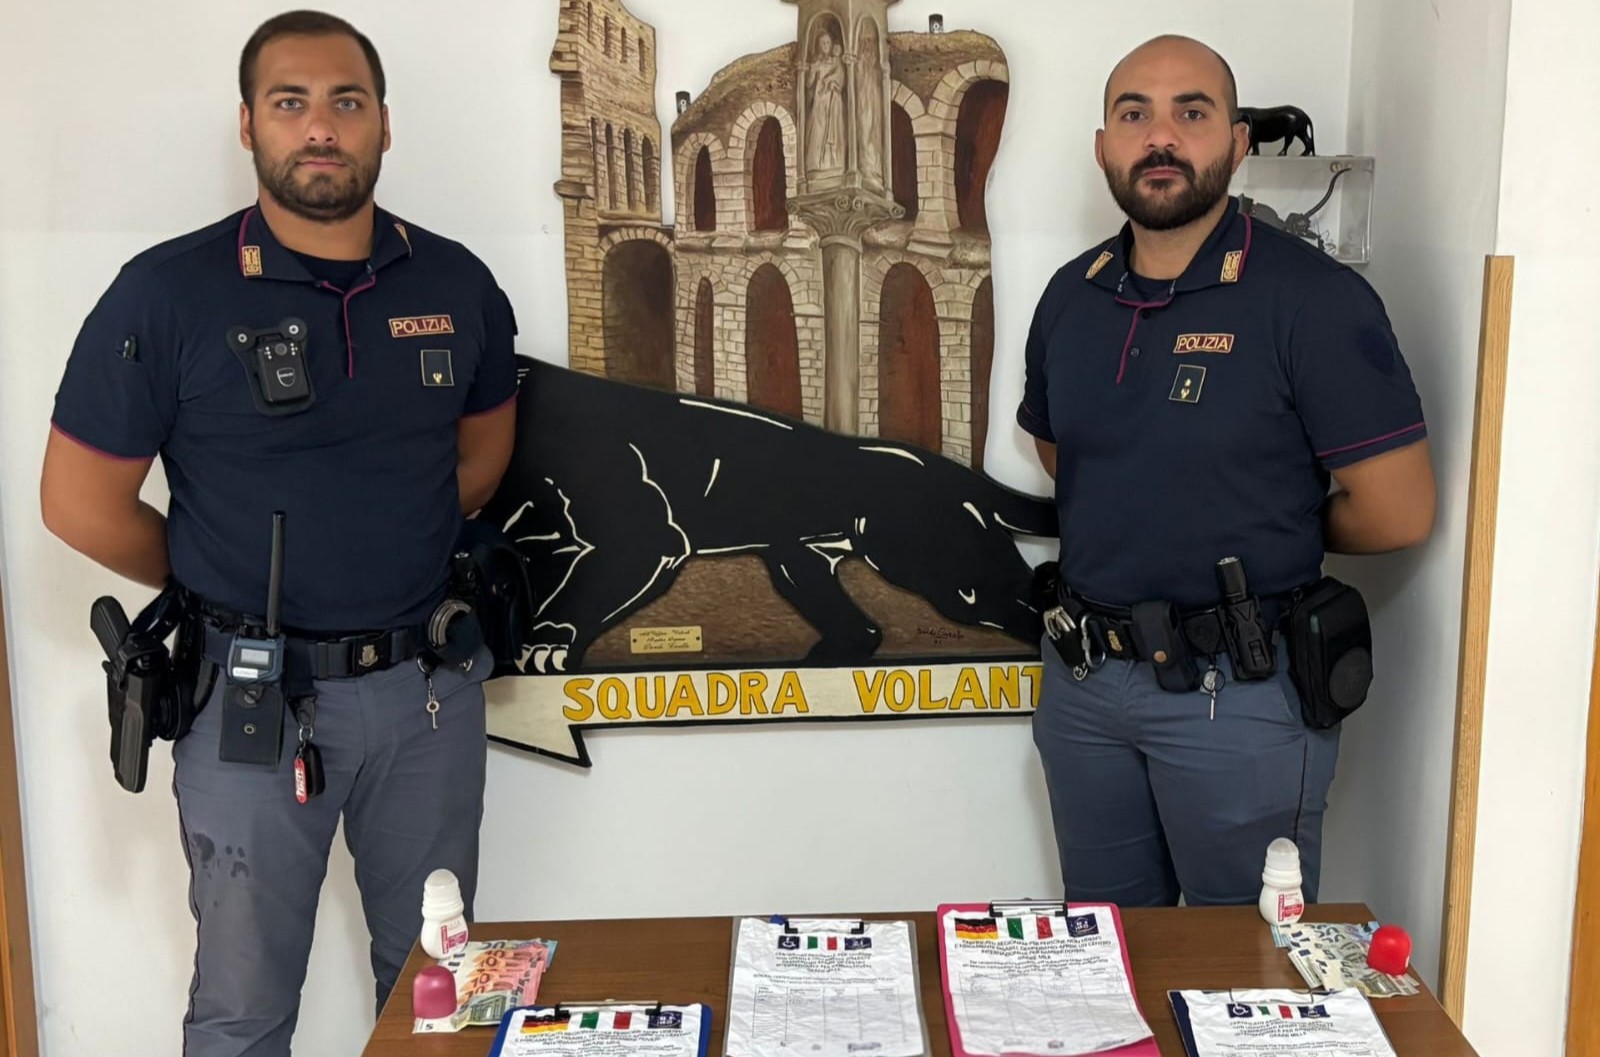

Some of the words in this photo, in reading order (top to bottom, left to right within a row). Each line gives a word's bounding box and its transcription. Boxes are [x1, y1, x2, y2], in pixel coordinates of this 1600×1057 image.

[392, 317, 451, 335] POLIZIA
[1178, 336, 1229, 350] POLIZIA
[563, 671, 809, 721] SQUADRA
